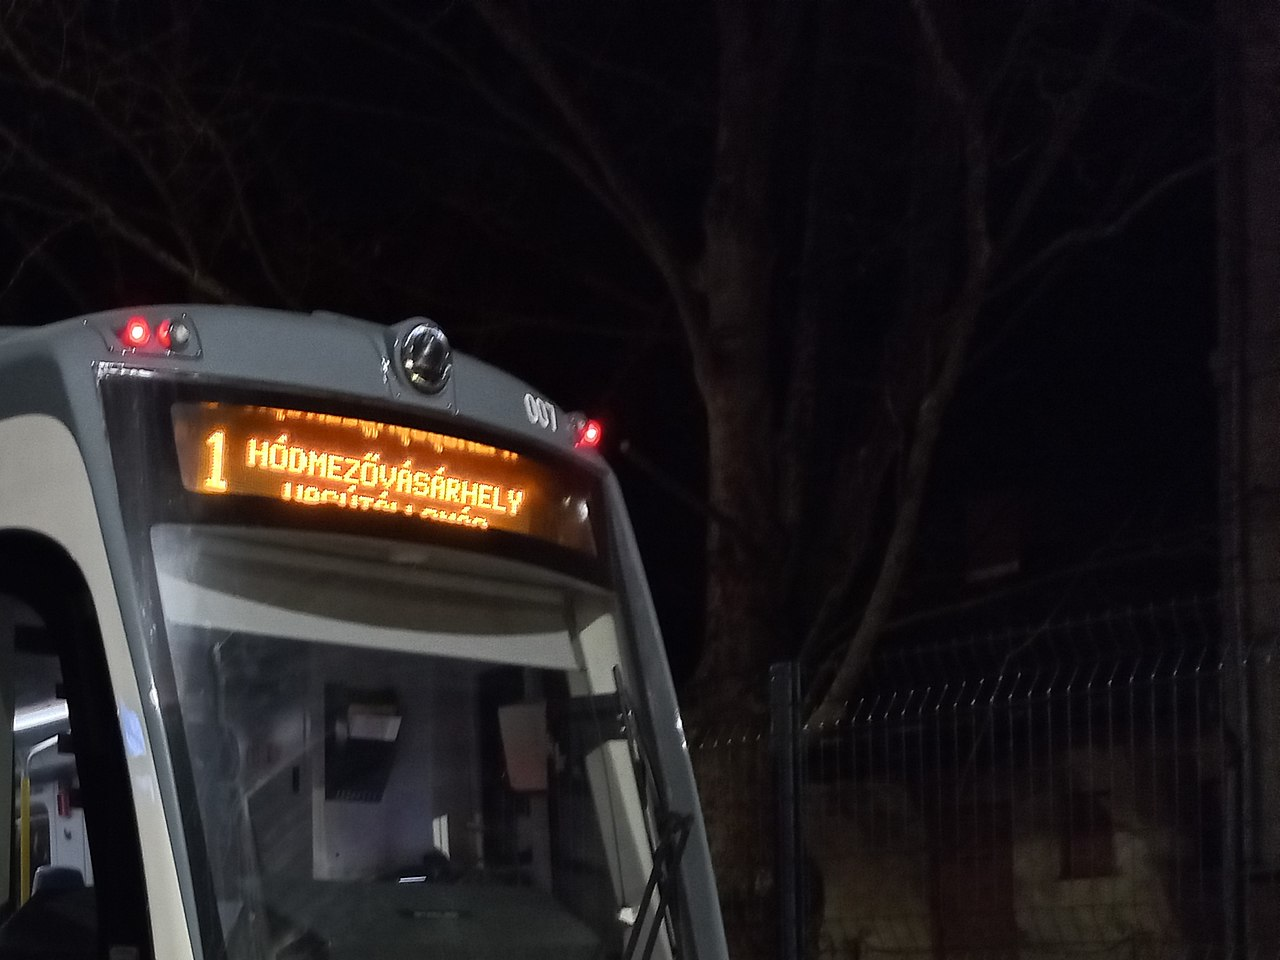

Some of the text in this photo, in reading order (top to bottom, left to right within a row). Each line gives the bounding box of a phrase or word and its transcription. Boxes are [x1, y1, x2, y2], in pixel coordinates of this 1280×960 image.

[524, 393, 558, 433] 007
[204, 431, 228, 493] 1
[247, 433, 526, 516] HÓDMEZŐVÁSÁRHELY
